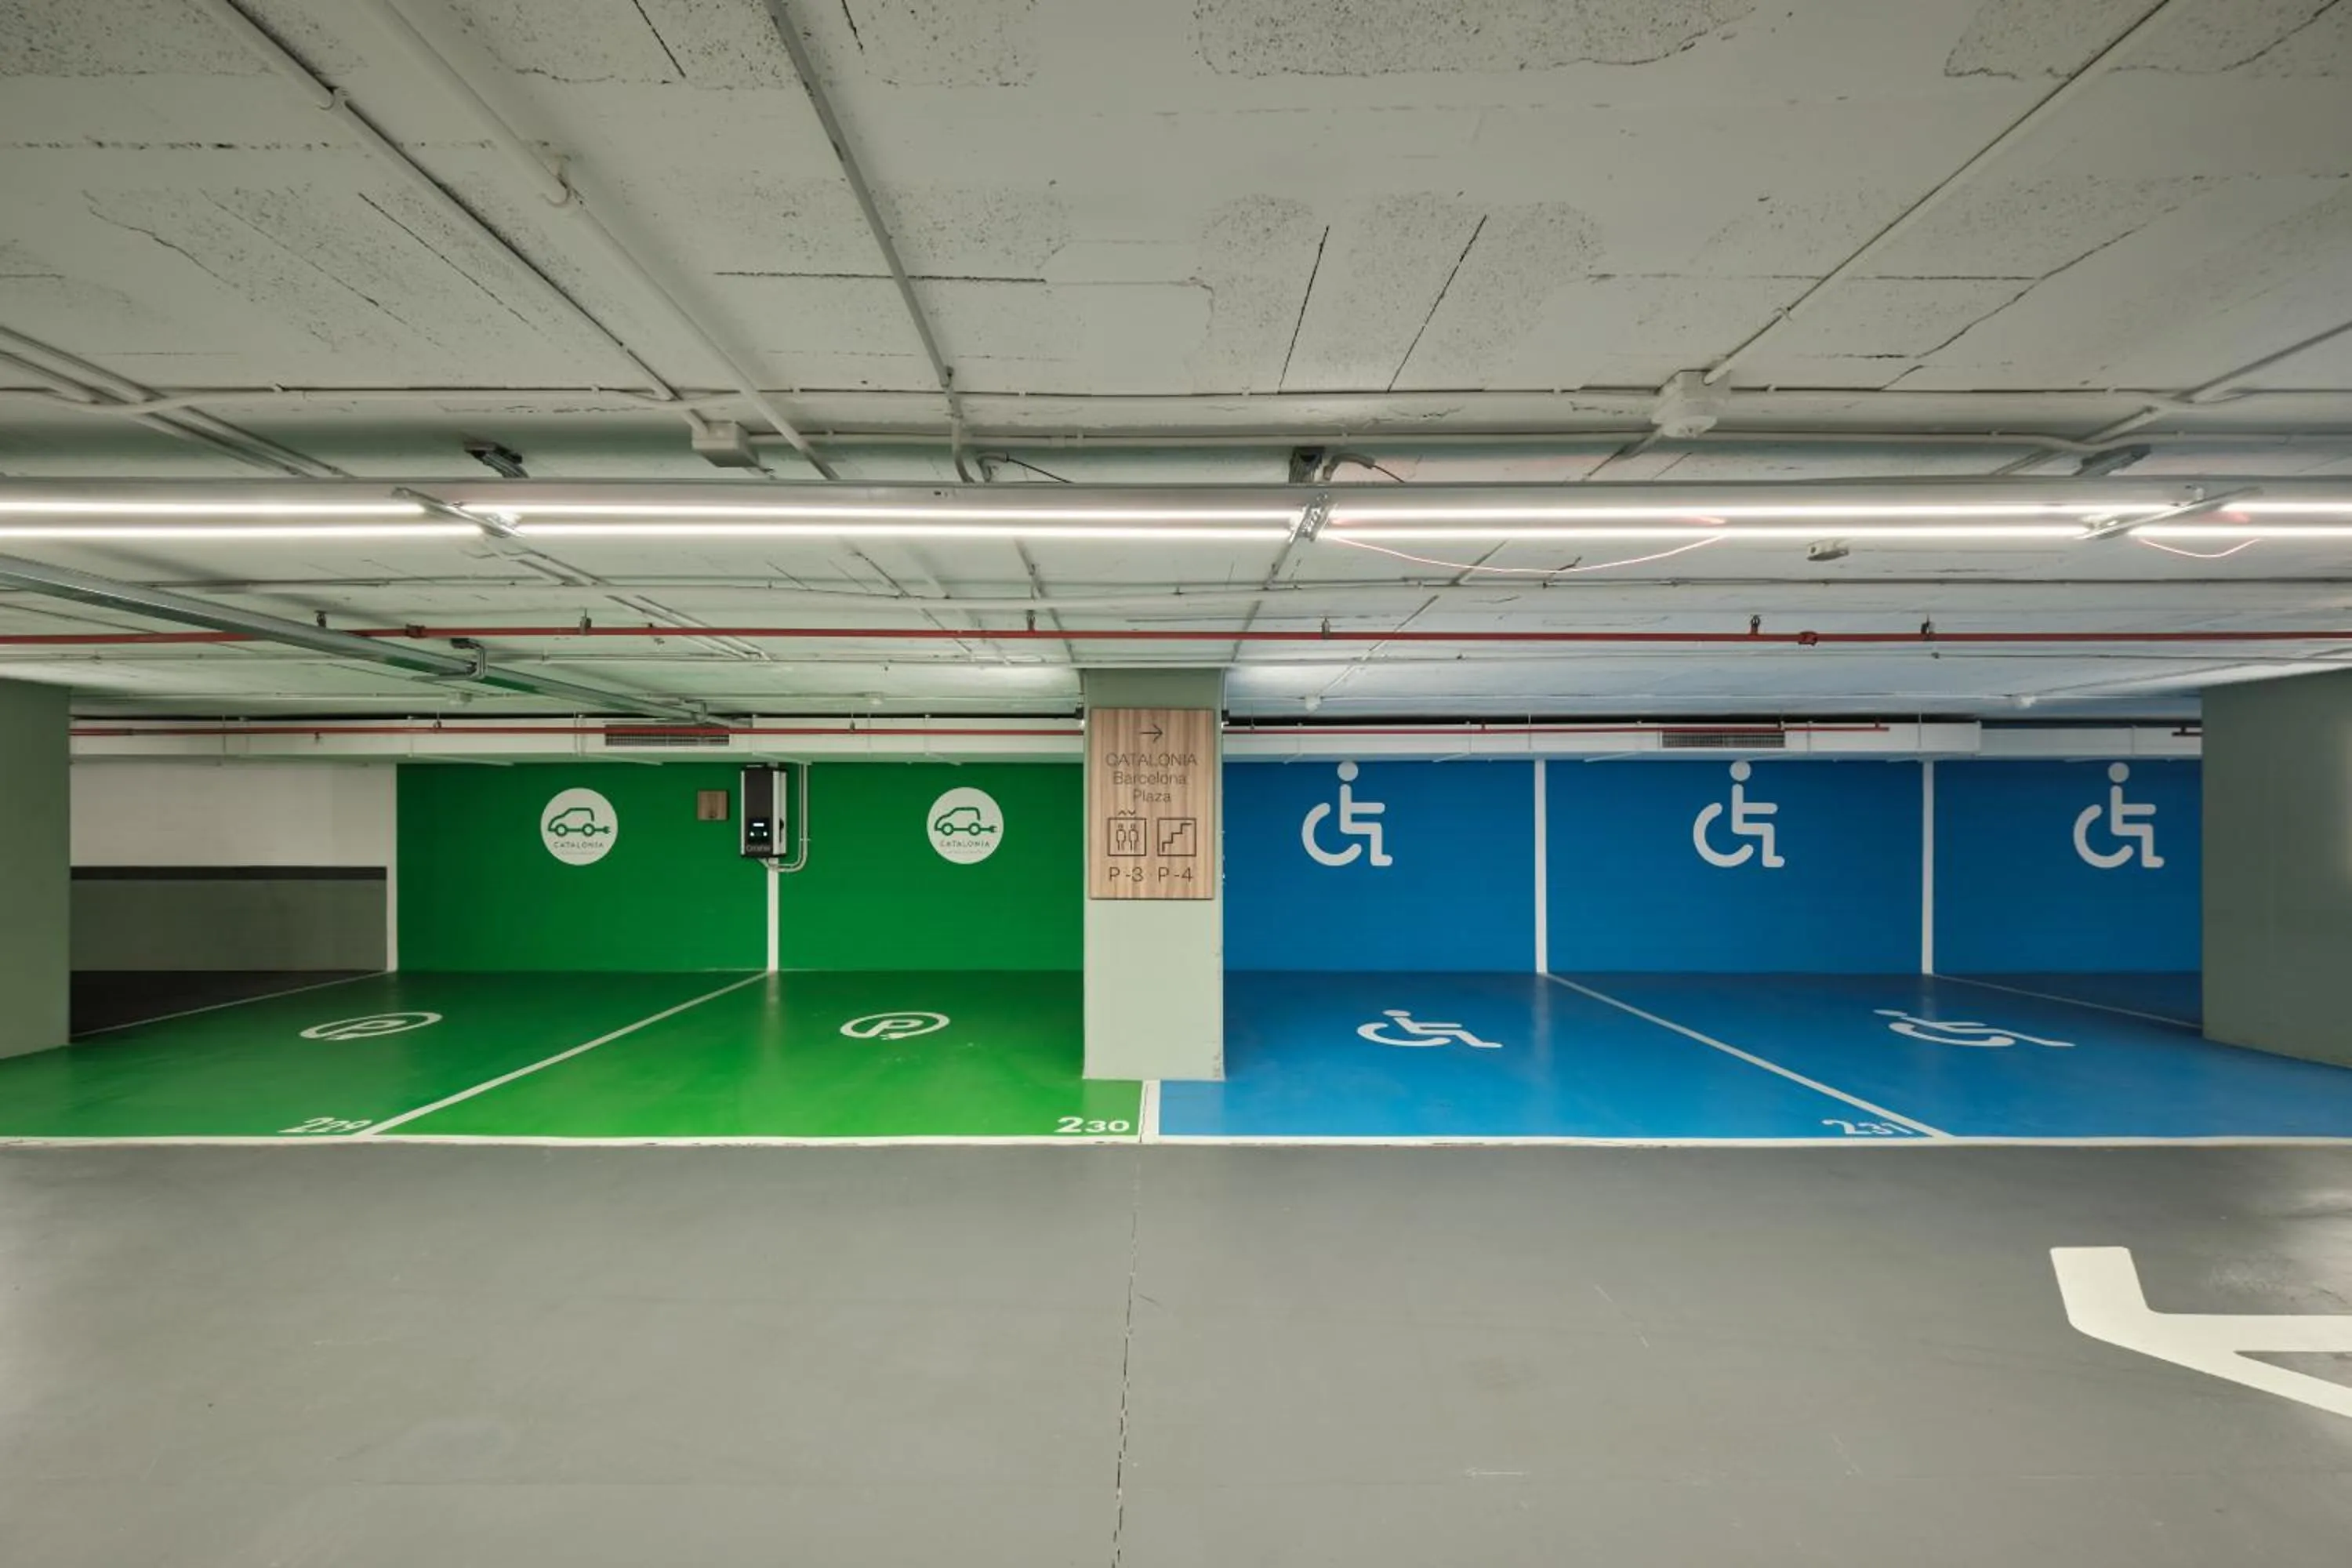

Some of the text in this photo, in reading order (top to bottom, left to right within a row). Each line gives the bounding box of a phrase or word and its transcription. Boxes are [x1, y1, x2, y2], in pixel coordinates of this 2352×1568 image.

[1105, 753, 1197, 767] CATALONIA
[1113, 771, 1187, 785] Barcelona
[1133, 788, 1171, 803] Plaza
[1054, 1116, 1131, 1134] 230
